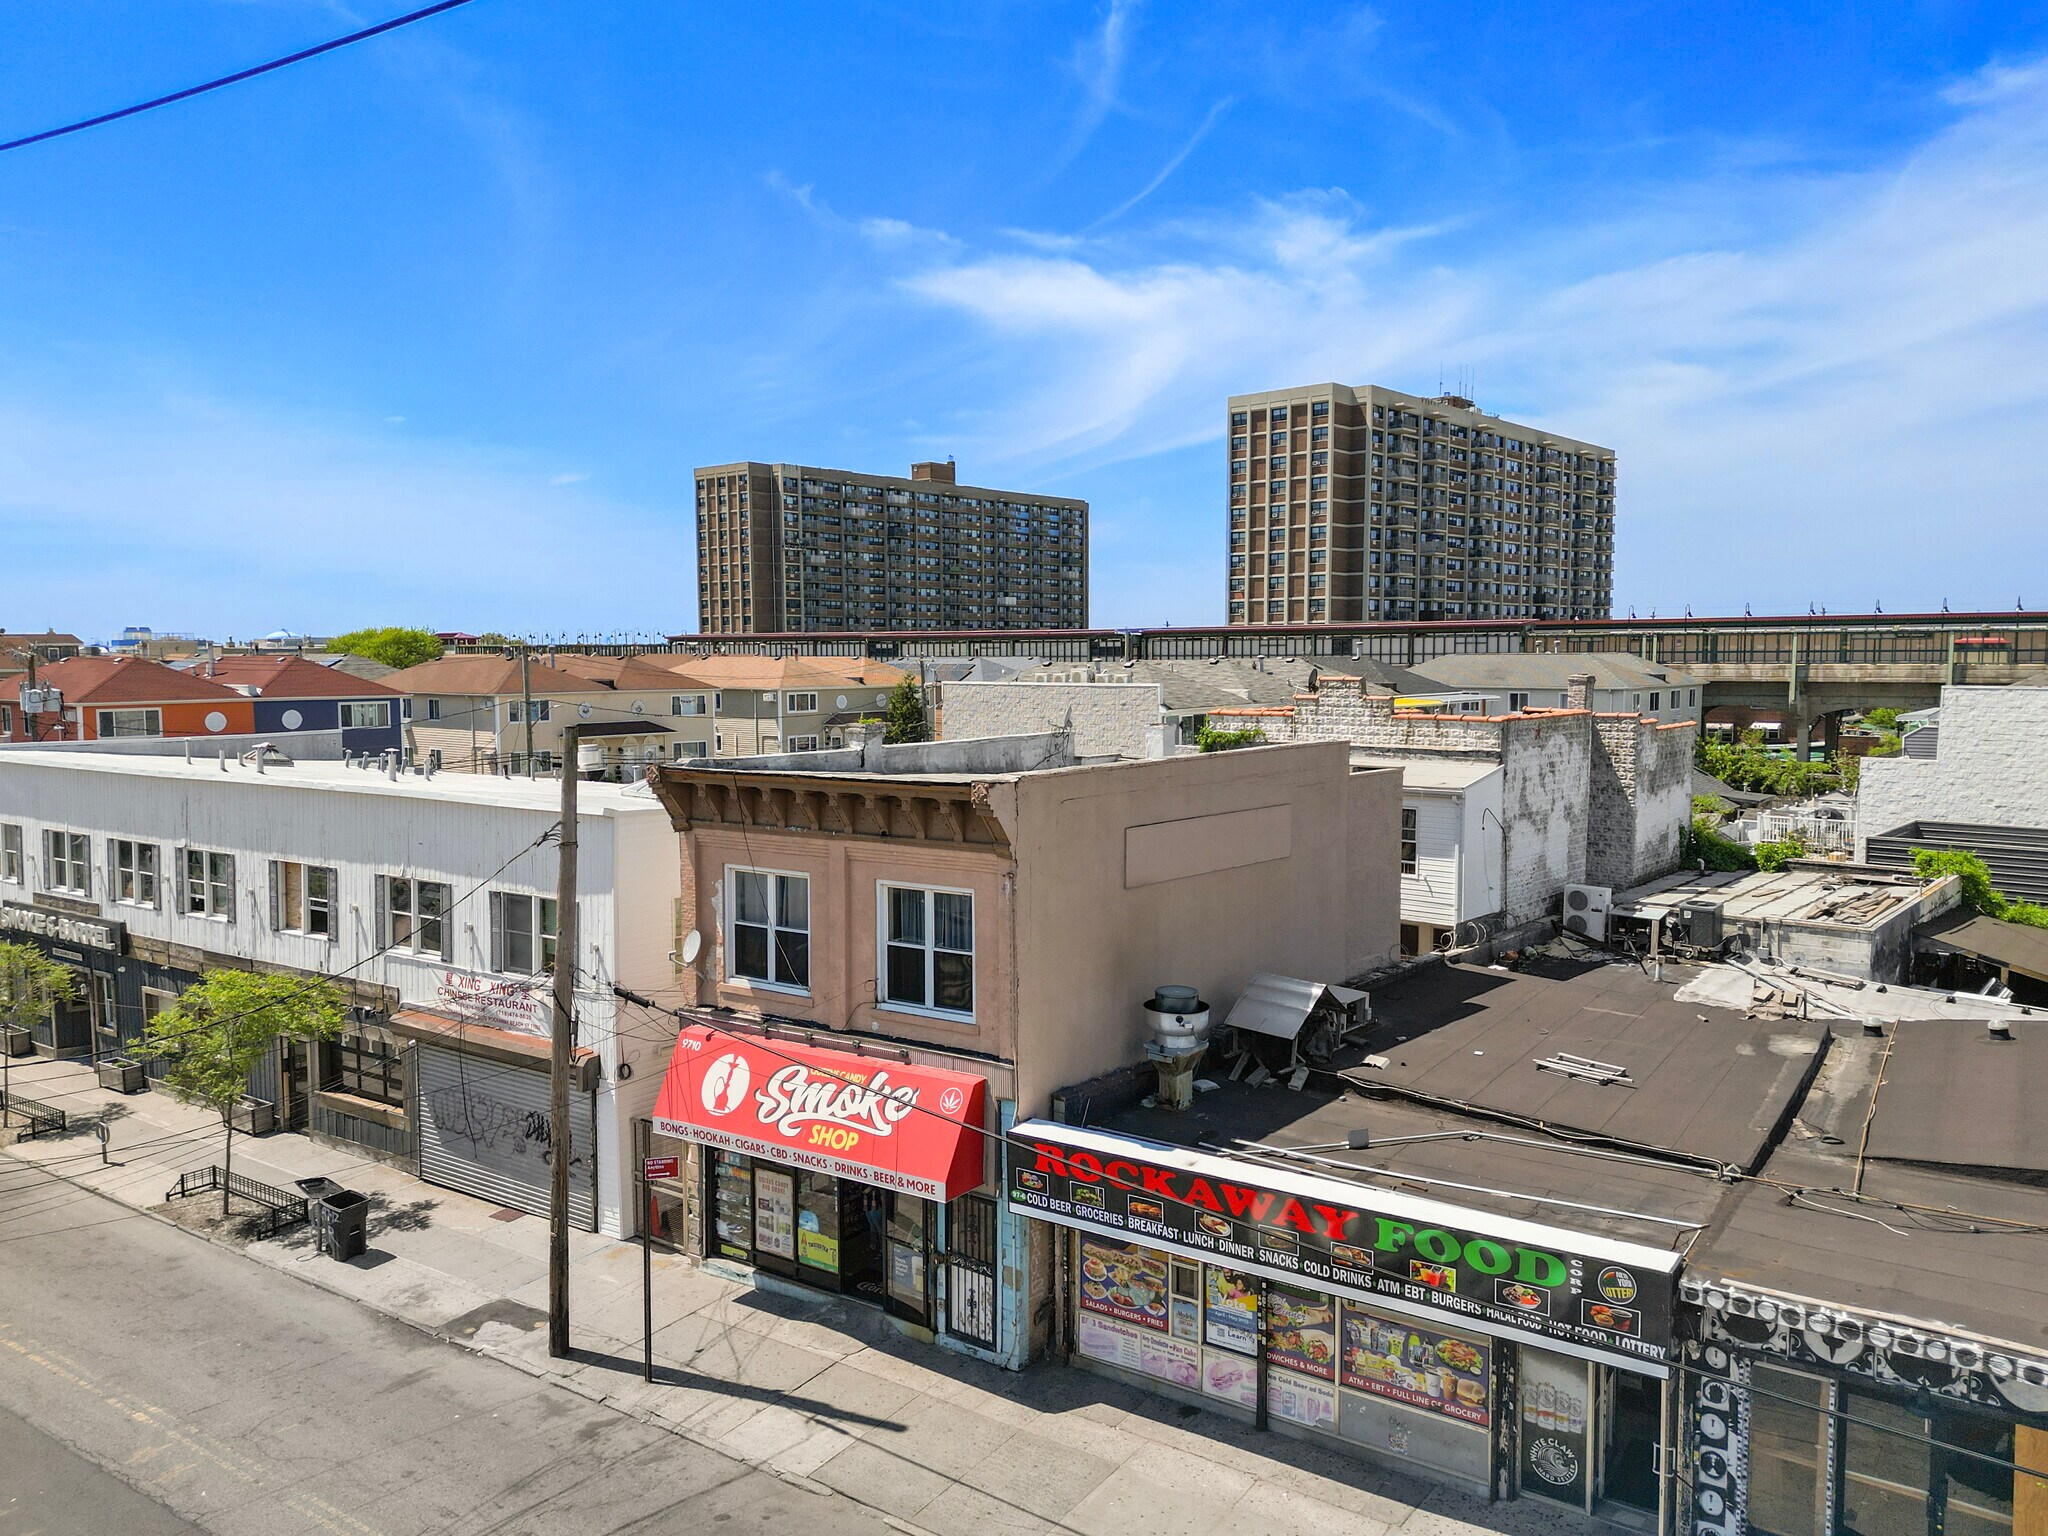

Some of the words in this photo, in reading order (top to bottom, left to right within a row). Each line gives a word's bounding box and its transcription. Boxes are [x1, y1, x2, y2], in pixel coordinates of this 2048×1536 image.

[1, 907, 46, 934] SMOKE
[47, 916, 59, 937] &
[59, 918, 115, 950] BARREL
[458, 976, 482, 991] XING
[489, 981, 516, 997] XING
[437, 986, 473, 1003] CHINESE
[474, 995, 538, 1013] RESTAURANT
[681, 1039, 702, 1052] 9710
[839, 1070, 867, 1084] CANDY
[755, 1064, 921, 1138] Smoke
[808, 1124, 859, 1152] SHOP
[660, 1121, 689, 1137] BONGS
[692, 1128, 731, 1146] HOOKAH
[735, 1138, 766, 1155] CIGARS
[770, 1146, 788, 1159] CBD
[792, 1152, 828, 1170] SNACKS
[834, 1161, 868, 1179] DRINKS
[873, 1171, 897, 1187] BEER
[897, 1175, 905, 1188] &
[906, 1179, 936, 1195] MORE
[1033, 1142, 1360, 1241] ROCKAWAY
[1373, 1217, 1567, 1288] FOOD
[1569, 1259, 1583, 1295] CORP
[1026, 1193, 1048, 1209] COLD
[1049, 1197, 1072, 1214] BEER
[1075, 1203, 1124, 1227] GROCERIES
[1127, 1217, 1179, 1241] BREAKFAST
[1183, 1232, 1214, 1250] LUNCH
[1218, 1240, 1255, 1260] DINNER
[1258, 1249, 1299, 1271] SNACKS
[1303, 1260, 1330, 1278] COLD
[1332, 1266, 1372, 1289] DRINKS
[1377, 1279, 1400, 1295] ATM
[1404, 1284, 1426, 1301] EBT
[1431, 1292, 1482, 1316] BURGERS
[1486, 1307, 1517, 1324] HALAL
[1574, 1327, 1608, 1346] FOOD
[1615, 1335, 1666, 1360] LOTTERY
[1617, 1278, 1633, 1288] YORK
[1218, 1293, 1247, 1310] Vote
[1085, 1300, 1108, 1313] SALADS
[1113, 1307, 1141, 1322] BURGERS
[1147, 1317, 1164, 1328] FRIES
[1098, 1320, 1138, 1339] Sandwiches
[1227, 1331, 1247, 1342] Learn
[1299, 1361, 1306, 1369] &
[1306, 1364, 1328, 1375] MORE
[1278, 1376, 1292, 1386] Cold
[1293, 1380, 1308, 1390] Beer
[1317, 1387, 1334, 1397] Soda
[1348, 1376, 1364, 1386] ATM
[1371, 1382, 1385, 1392] EBT
[1392, 1388, 1410, 1400] FULL
[1412, 1394, 1429, 1406] LINE
[1444, 1404, 1482, 1421] GROCERY
[1529, 1437, 1547, 1462] WHITE
[1547, 1437, 1575, 1458] CLAW
[1537, 1466, 1555, 1481] HARD
[1556, 1464, 1576, 1483] SELTZER
